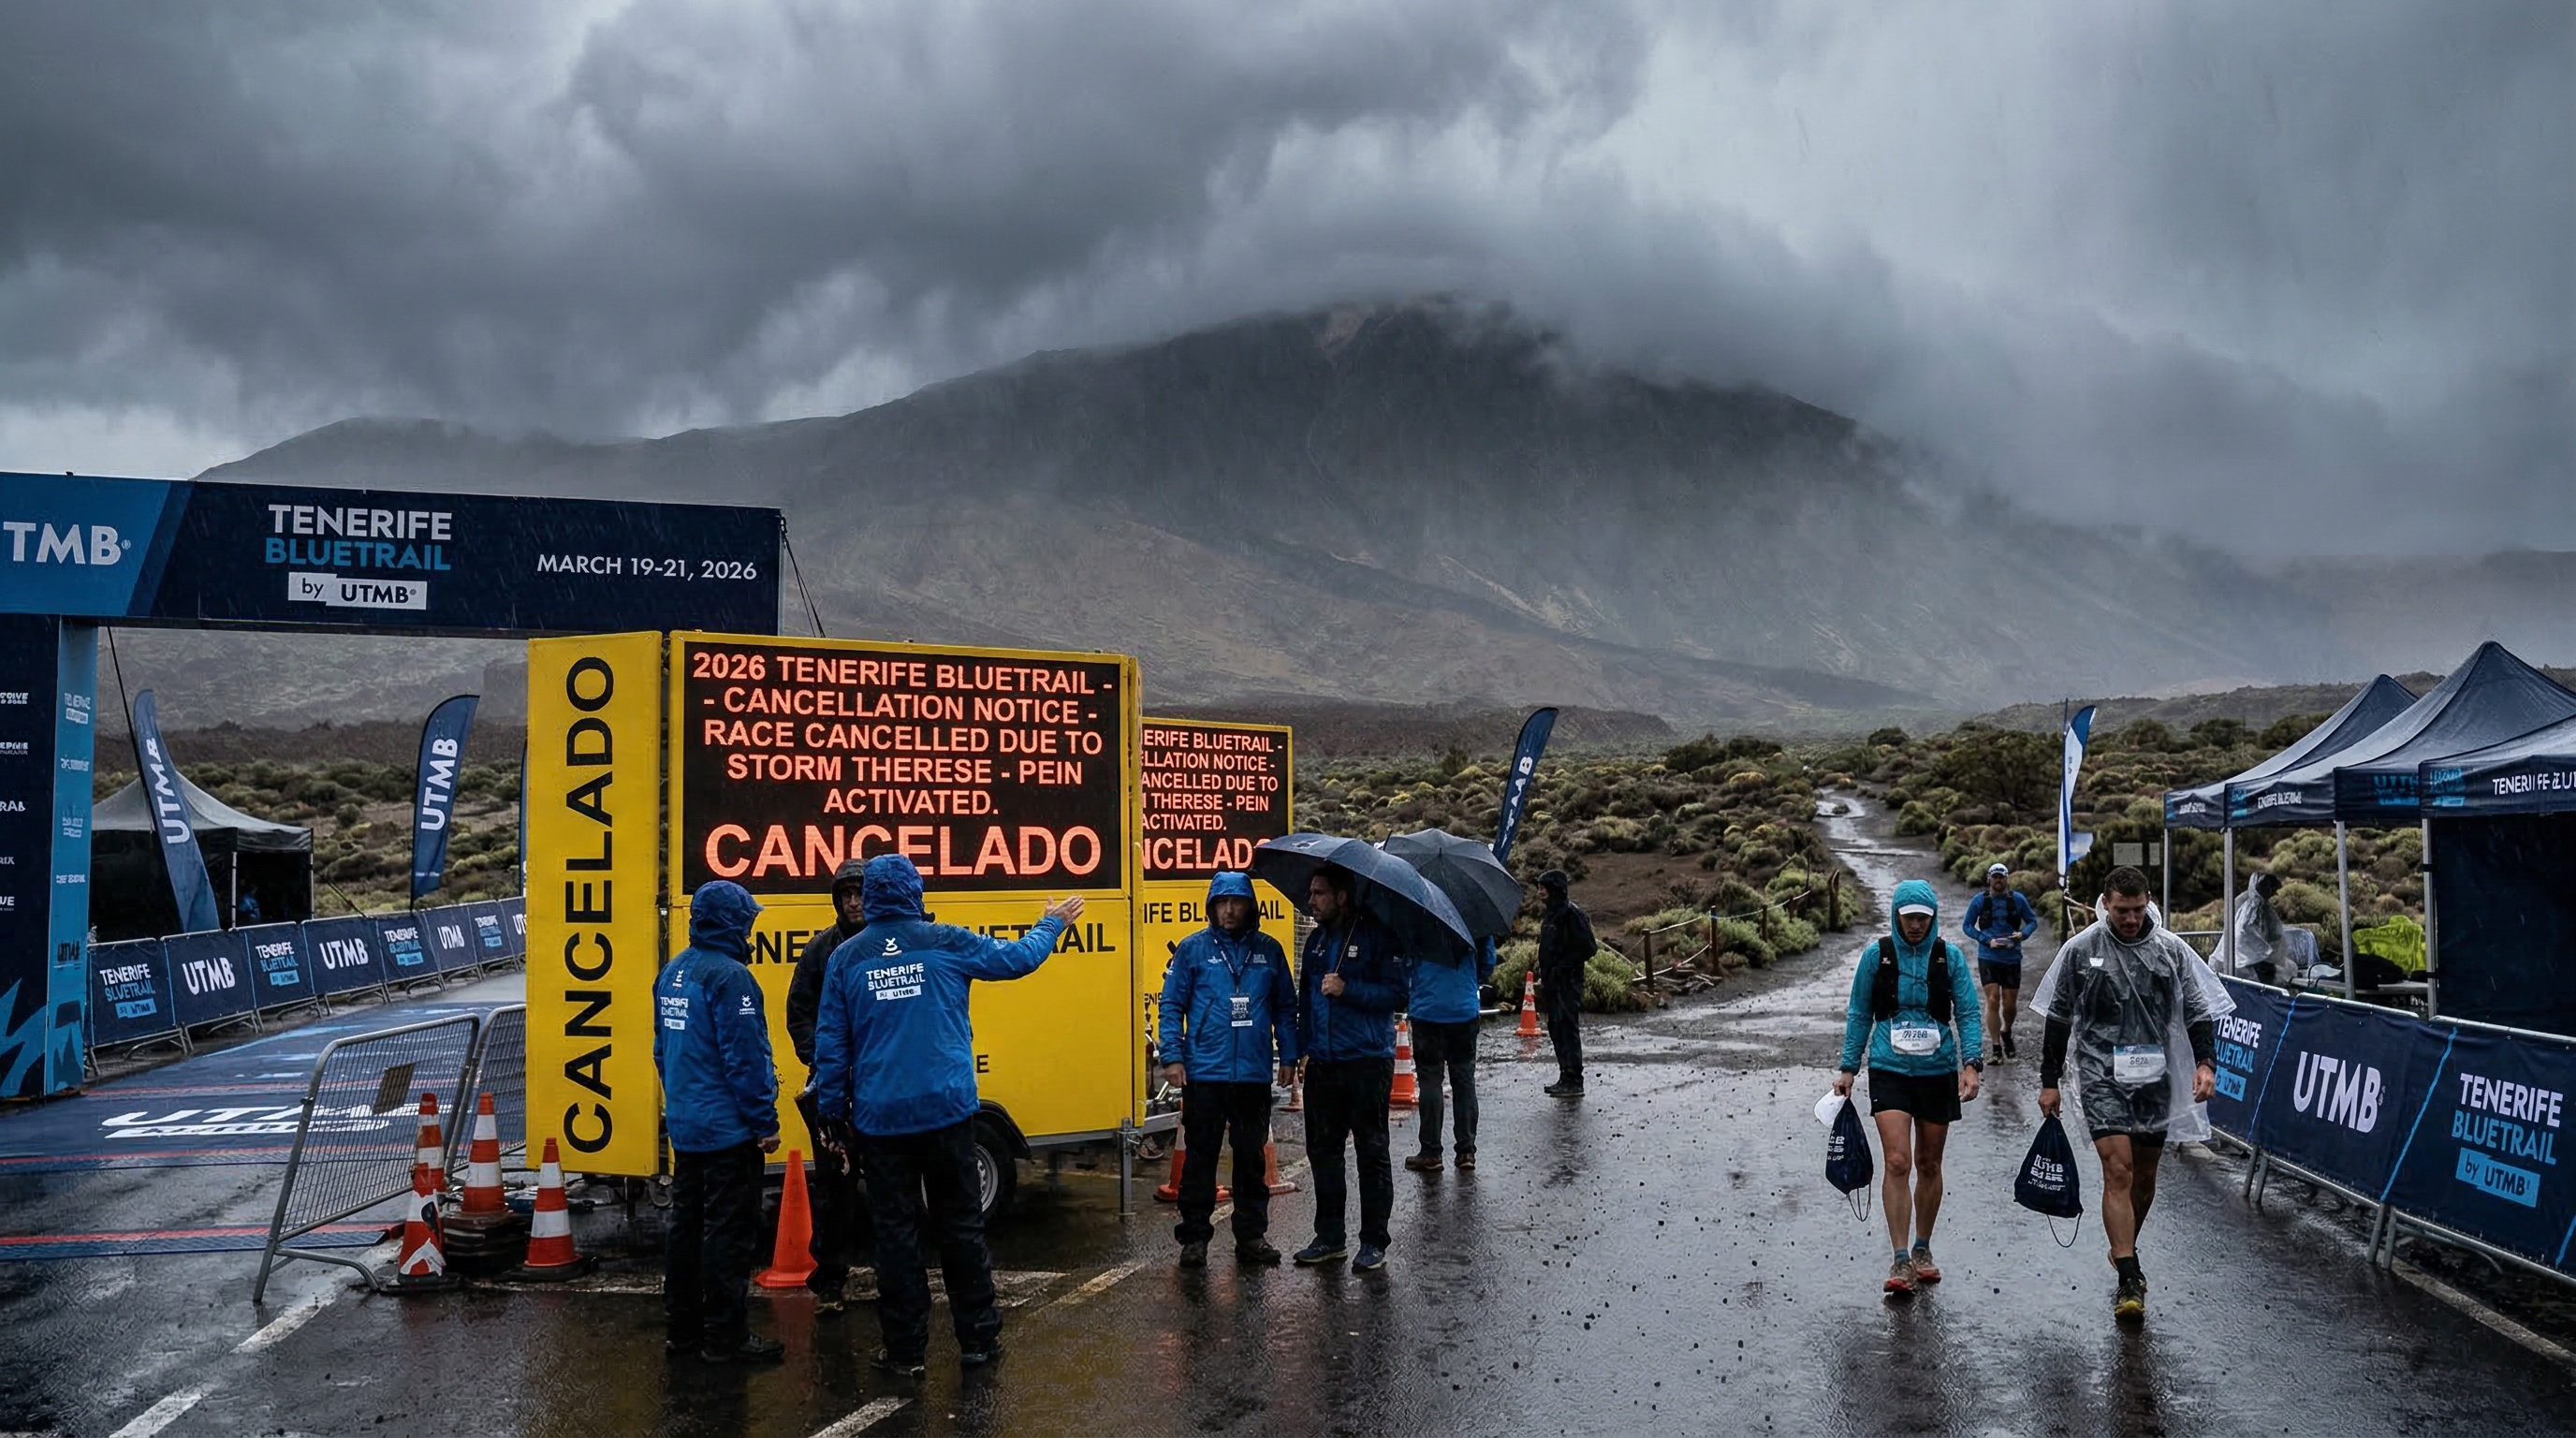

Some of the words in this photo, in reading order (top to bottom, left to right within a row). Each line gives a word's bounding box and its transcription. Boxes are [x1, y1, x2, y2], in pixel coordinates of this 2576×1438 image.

[269, 505, 452, 540] TENERIFE
[266, 537, 451, 570] BLUETRAIL
[536, 554, 622, 575] MARCH
[631, 558, 694, 581] 19-21,
[701, 560, 757, 580] 2026
[301, 578, 324, 599] by
[693, 653, 766, 681] 2026
[776, 655, 927, 687] TENERIFE
[936, 664, 1095, 695] BLUETRAIL
[724, 686, 963, 720] CANCELLATION
[973, 697, 1079, 724] NOTICE
[704, 719, 794, 747] RACE
[805, 722, 989, 753] CANCELLED
[1000, 728, 1057, 754] DUE
[1065, 730, 1103, 756] TO
[1141, 729, 1189, 748] ERIFE
[1193, 732, 1275, 753] BLUETRAIL
[727, 753, 842, 781] STORM
[851, 756, 992, 785] THERESE
[1019, 760, 1082, 785] PEIN
[1213, 755, 1267, 771] NOTICE
[146, 738, 190, 844] UTMB
[420, 738, 459, 831] UTMB
[1225, 775, 1255, 791] DUE
[1259, 776, 1279, 792] TO
[824, 787, 999, 815] ACTIVATED.
[1150, 793, 1223, 811] THERESE
[1236, 796, 1269, 812] PEIN
[1141, 813, 1227, 830] ACTIVATED.
[706, 824, 1102, 877] CANCELADO
[1142, 837, 1271, 870] NCELAD
[564, 656, 614, 1153] CANCELADO
[319, 937, 369, 970] UTMB
[99, 963, 152, 986] TENERIFE
[182, 957, 236, 995] UTMB
[866, 963, 925, 981] TENERIFE
[2217, 1015, 2262, 1049] TENERIFE
[2293, 1050, 2381, 1134] UTMB
[2460, 1073, 2564, 1128] TENERIFE
[2451, 1109, 2557, 1166] BLUETRAIL
[2465, 1153, 2481, 1181] by
